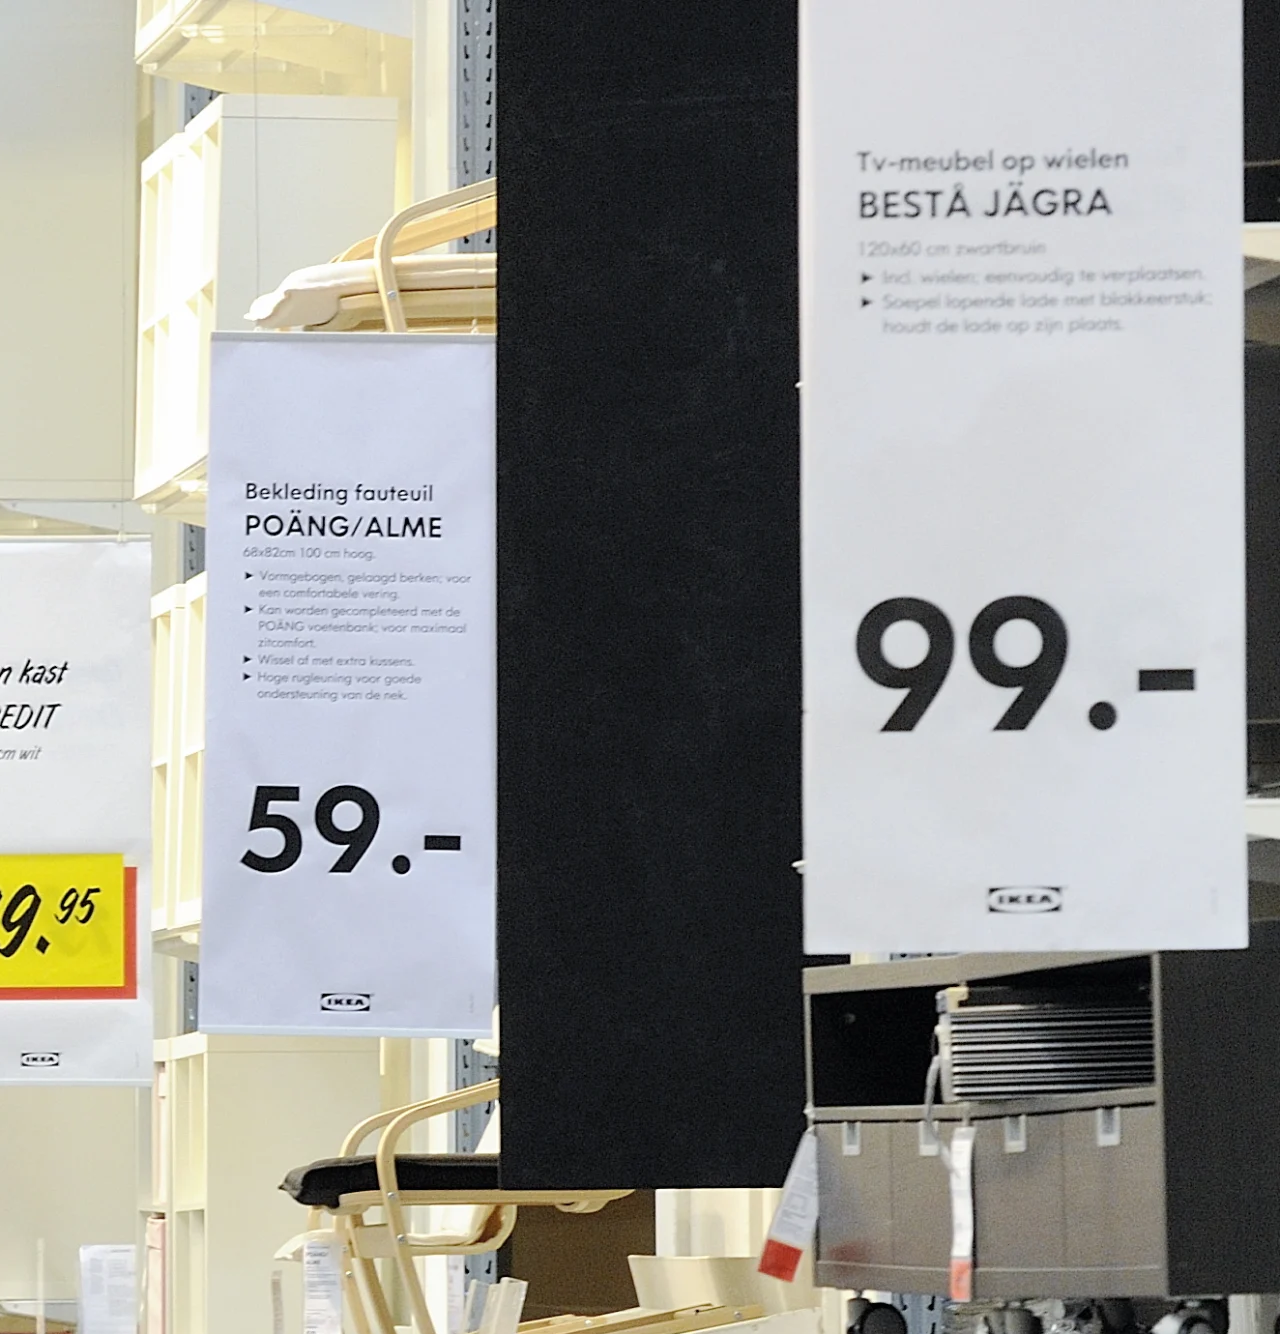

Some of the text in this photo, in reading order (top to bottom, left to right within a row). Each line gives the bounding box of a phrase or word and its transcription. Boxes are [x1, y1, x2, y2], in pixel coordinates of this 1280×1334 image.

[857, 147, 1130, 177] Tv-meubel op wielen
[858, 180, 1113, 220] BESTÅ JÄGRA
[245, 482, 434, 505] Bekleding fauteuil
[245, 509, 442, 538] POÄNG/ALME
[300, 547, 322, 559] 100
[324, 550, 341, 559] cm
[446, 575, 472, 584] voor
[258, 589, 281, 598] een
[283, 587, 359, 600] comfortabele
[258, 605, 461, 619] Kan worden gecompleteerd met de
[258, 618, 305, 632] POÄNG
[381, 624, 407, 634] voor
[410, 622, 468, 634] maximaal
[258, 654, 295, 666] Wissel
[311, 656, 333, 666] met
[336, 656, 367, 666] extra
[855, 595, 1195, 732] 99.-
[18, 658, 70, 685] kast
[257, 670, 423, 687] Hoge rugleuning voor goede
[256, 687, 338, 702] ondersteuning
[340, 690, 363, 700] van
[364, 689, 381, 700] de
[19, 745, 42, 761] wit
[239, 784, 462, 875] 59.-
